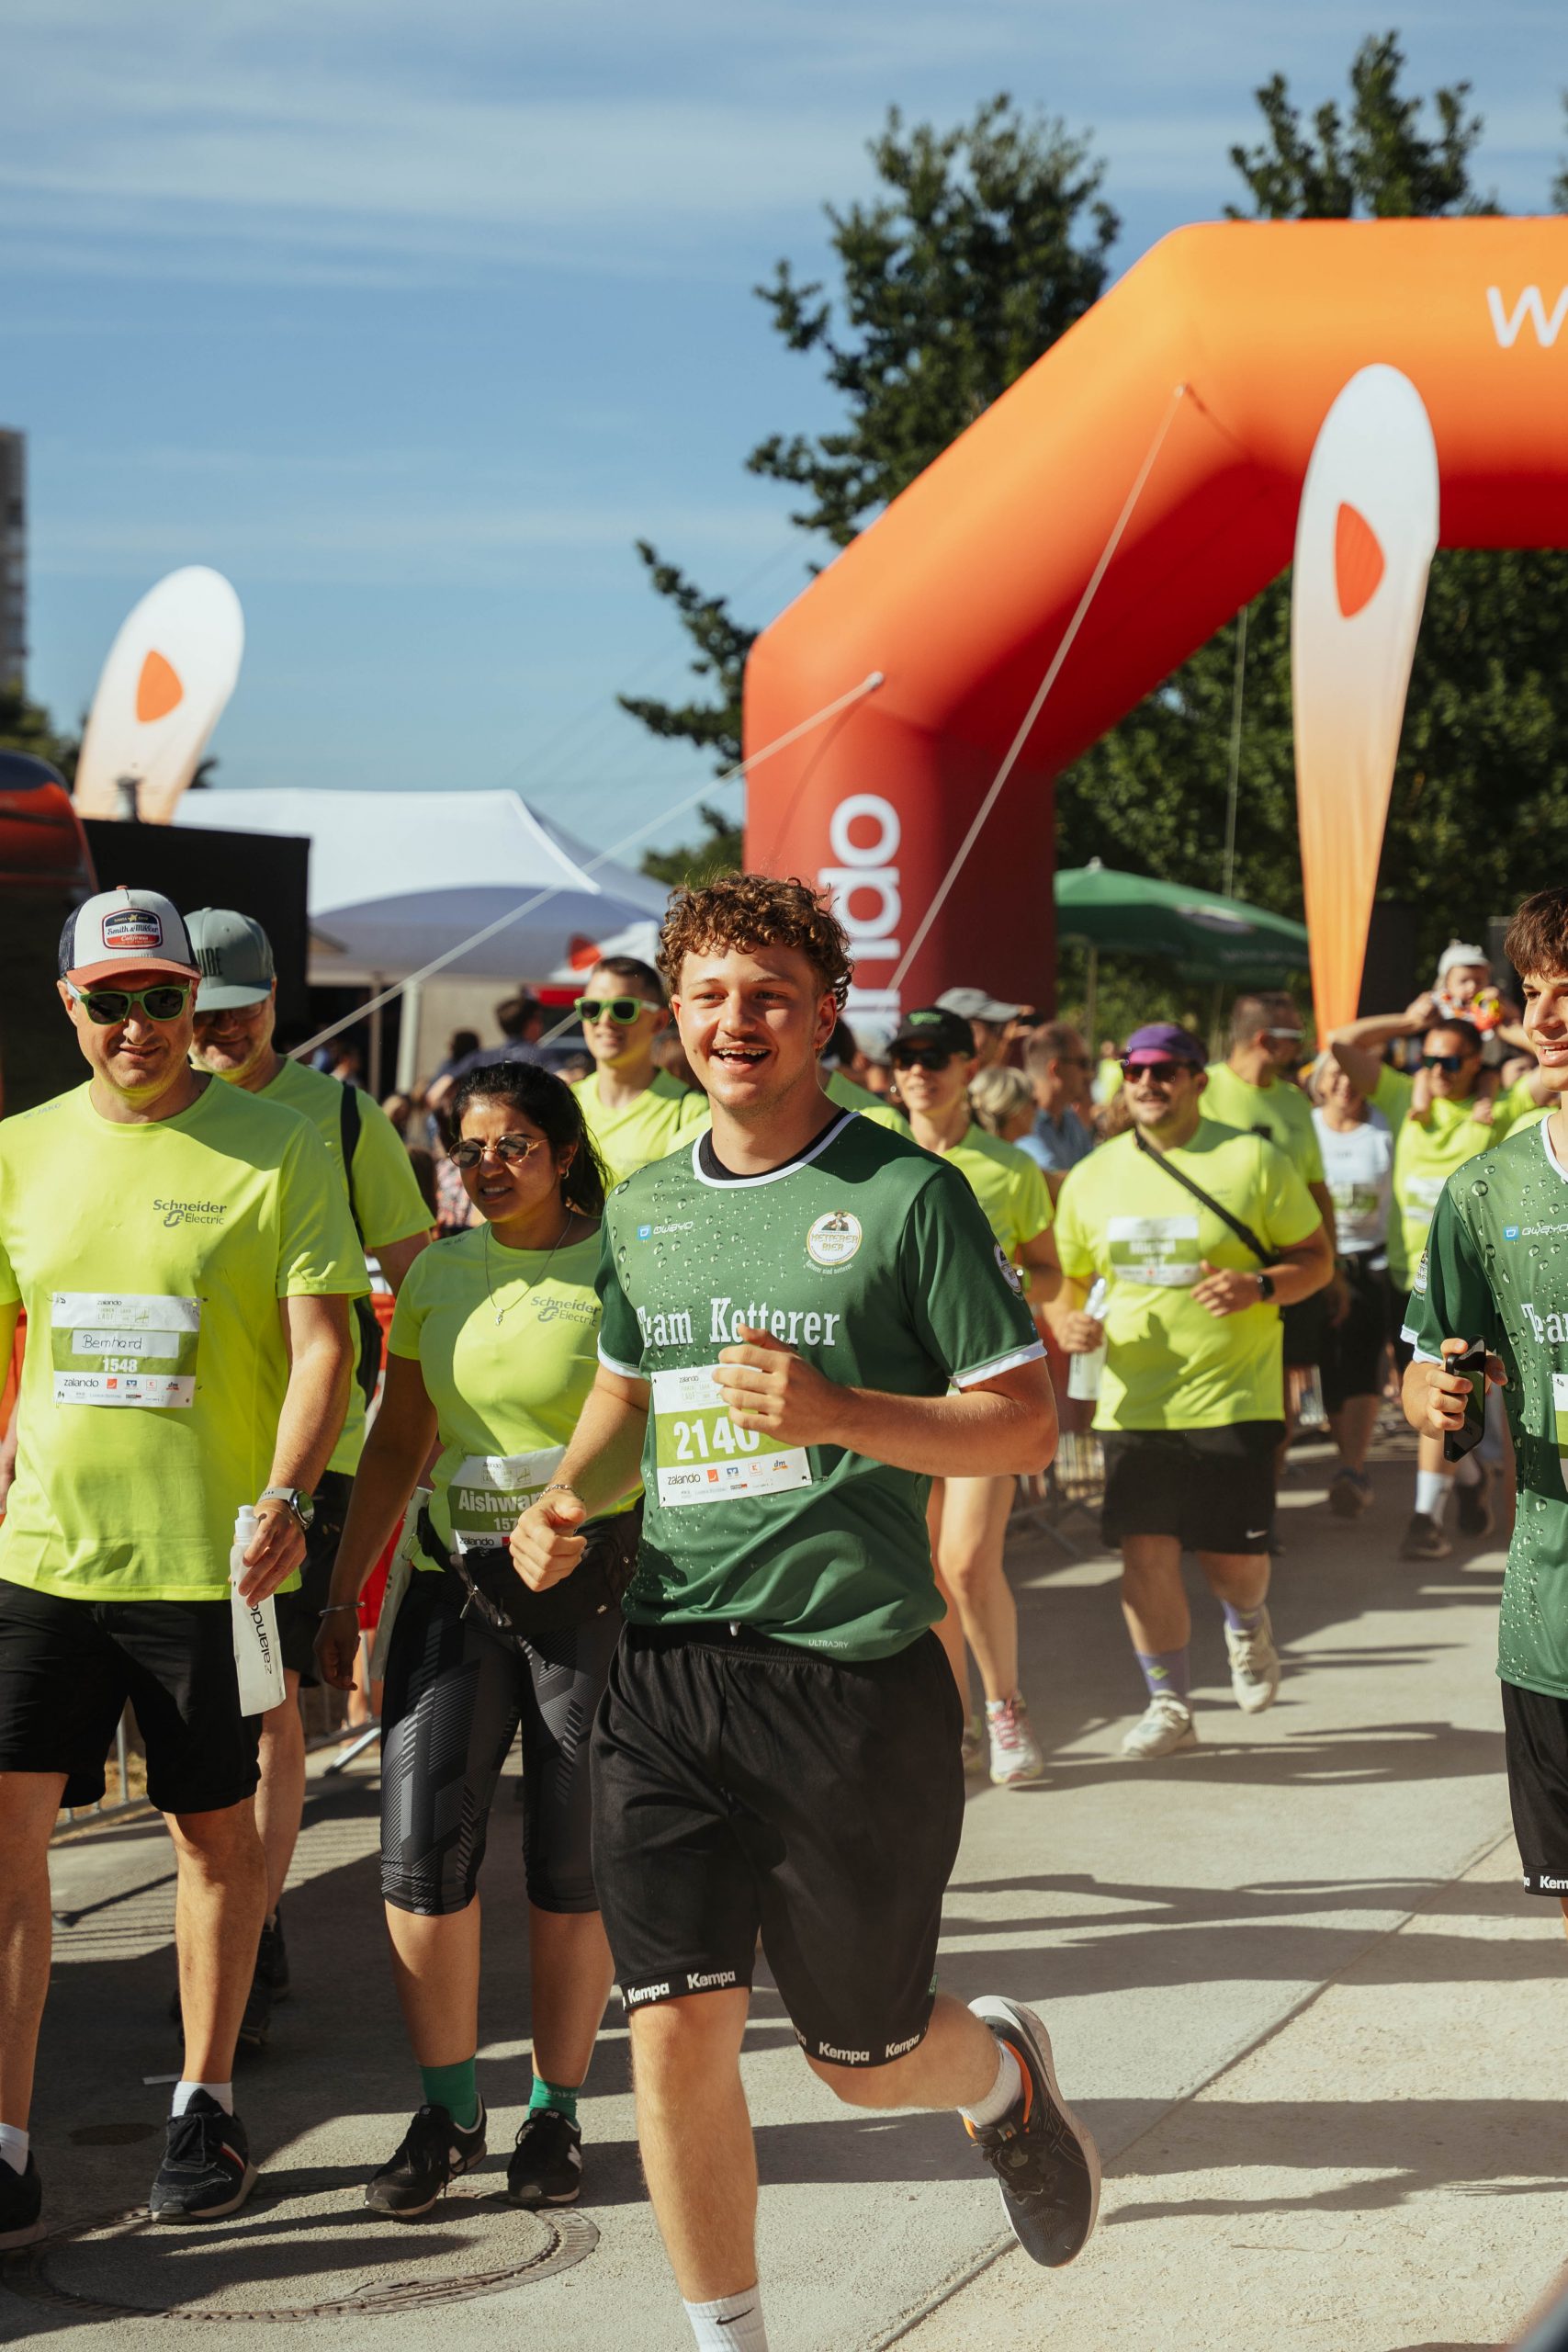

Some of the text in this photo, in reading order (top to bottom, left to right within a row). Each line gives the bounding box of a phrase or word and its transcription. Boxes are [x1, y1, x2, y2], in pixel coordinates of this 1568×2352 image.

[107, 925, 129, 935] Smith
[152, 1199, 227, 1214] Schneider
[185, 1213, 225, 1225] Electric
[530, 1295, 602, 1315] Schneider
[558, 1309, 598, 1328] Electric
[709, 1296, 840, 1346] Ketterer
[1520, 1303, 1568, 1344] Tea
[81, 1333, 142, 1351] Bernhard
[102, 1358, 138, 1373] 1548
[63, 1378, 99, 1387] zalando
[667, 1474, 701, 1486] zalando
[493, 1517, 519, 1531] 157
[459, 1537, 495, 1546] zalando
[1540, 1875, 1568, 1890] Kem
[627, 1981, 670, 2003] Kempa
[687, 1970, 736, 1989] Kempa
[818, 2033, 920, 2064] Kempa Kempa
